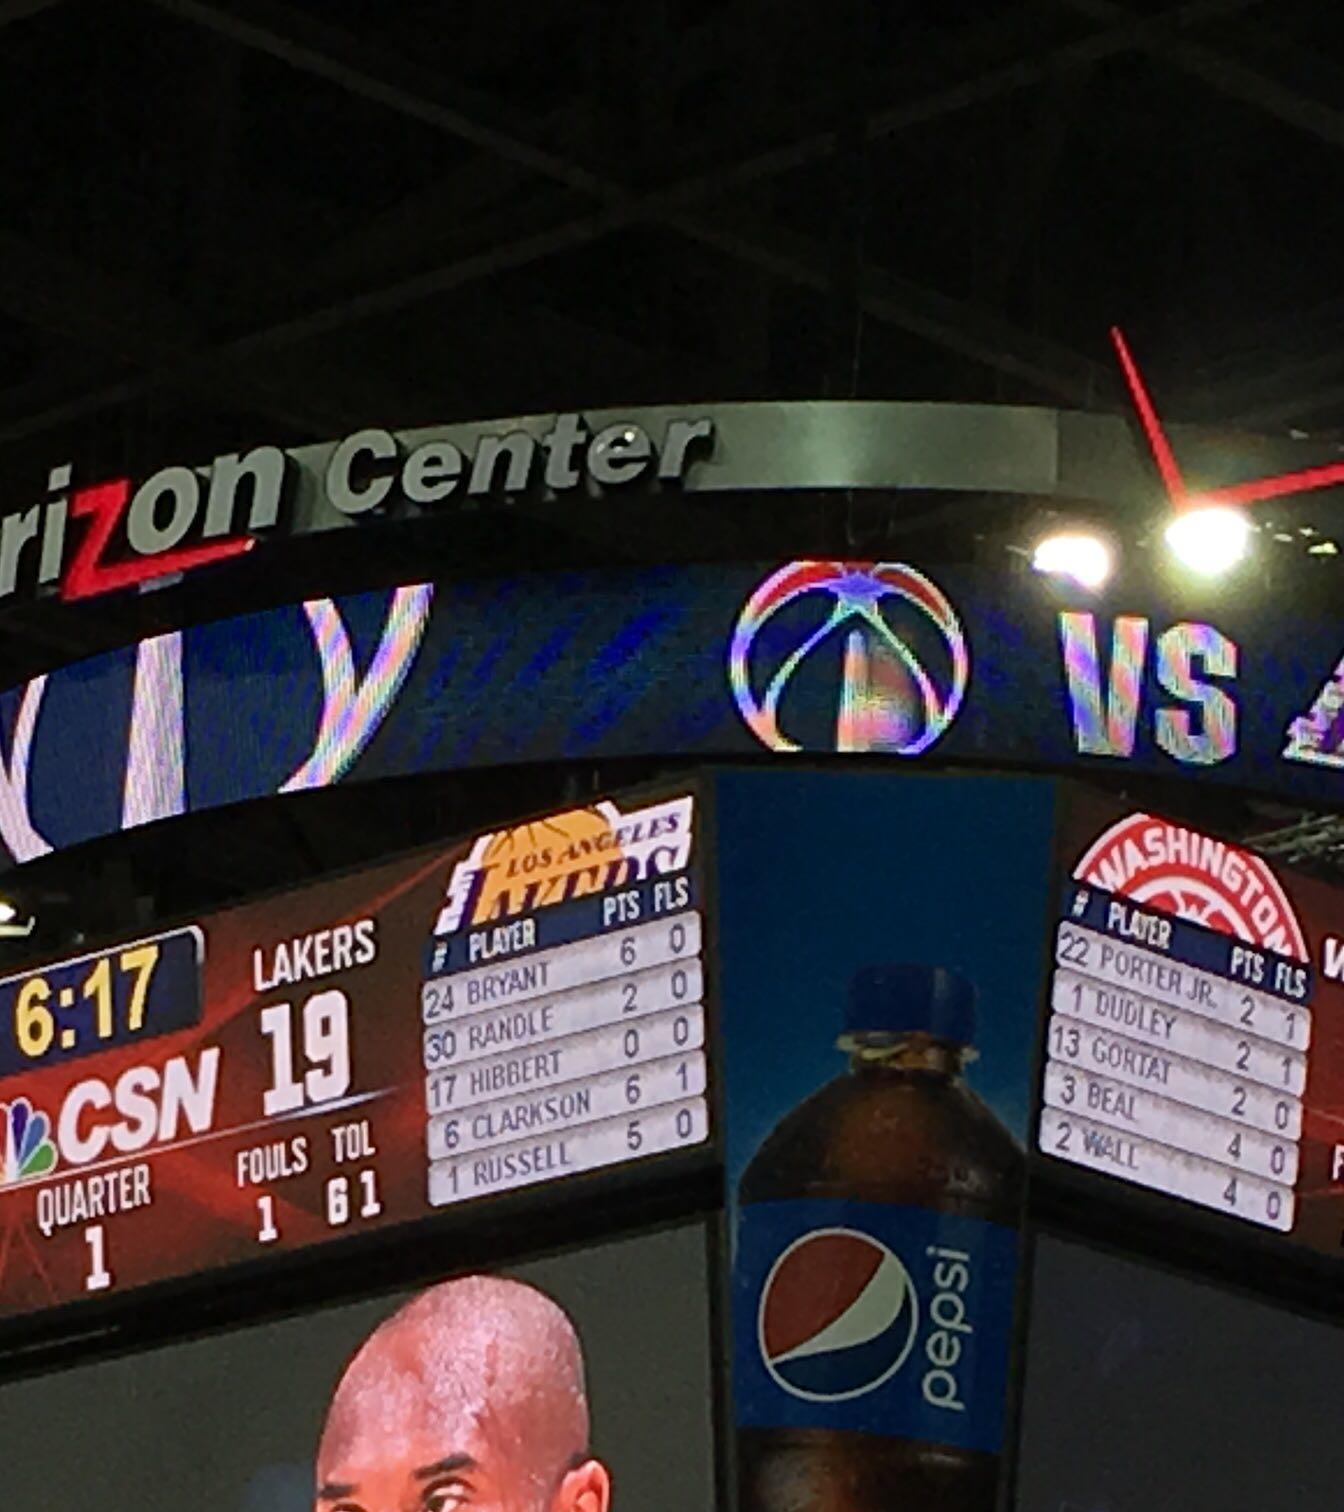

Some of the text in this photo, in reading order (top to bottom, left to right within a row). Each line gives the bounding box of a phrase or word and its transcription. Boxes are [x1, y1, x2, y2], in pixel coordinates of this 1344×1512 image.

[327, 416, 713, 514] Center
[1059, 611, 1237, 765] VS
[506, 812, 681, 878] LOS ANGELES
[469, 918, 536, 963] PLAYER
[603, 890, 639, 926] PTS
[654, 877, 689, 913] FLS
[1087, 825, 1294, 957] WASHINGTON
[254, 918, 376, 991] LAKERS
[1059, 932, 1089, 967] 22
[1100, 943, 1181, 997] PORTER
[1108, 901, 1306, 999] PLAYER PTS FLS
[16, 944, 158, 1058] 6:17
[426, 961, 550, 1020] 24 BRYANT
[1095, 989, 1177, 1040] DUDLEY
[260, 989, 351, 1117] 19
[427, 1011, 554, 1064] 30 RANDLE
[1055, 1025, 1172, 1084] 13 GORTAT
[59, 1046, 220, 1164] CSN
[428, 1050, 563, 1106] 17 HIBBERT
[1088, 1082, 1138, 1122] BEAL
[443, 1090, 591, 1148] 6 CLARKSON
[1083, 1128, 1139, 1170] WALL
[237, 1121, 376, 1187] FOULS TOL
[473, 1141, 571, 1186] RUSSELL
[37, 1164, 151, 1236] QUARTER
[257, 1196, 278, 1242] 1
[85, 1225, 110, 1291] 1
[922, 1245, 973, 1409] pepsi
